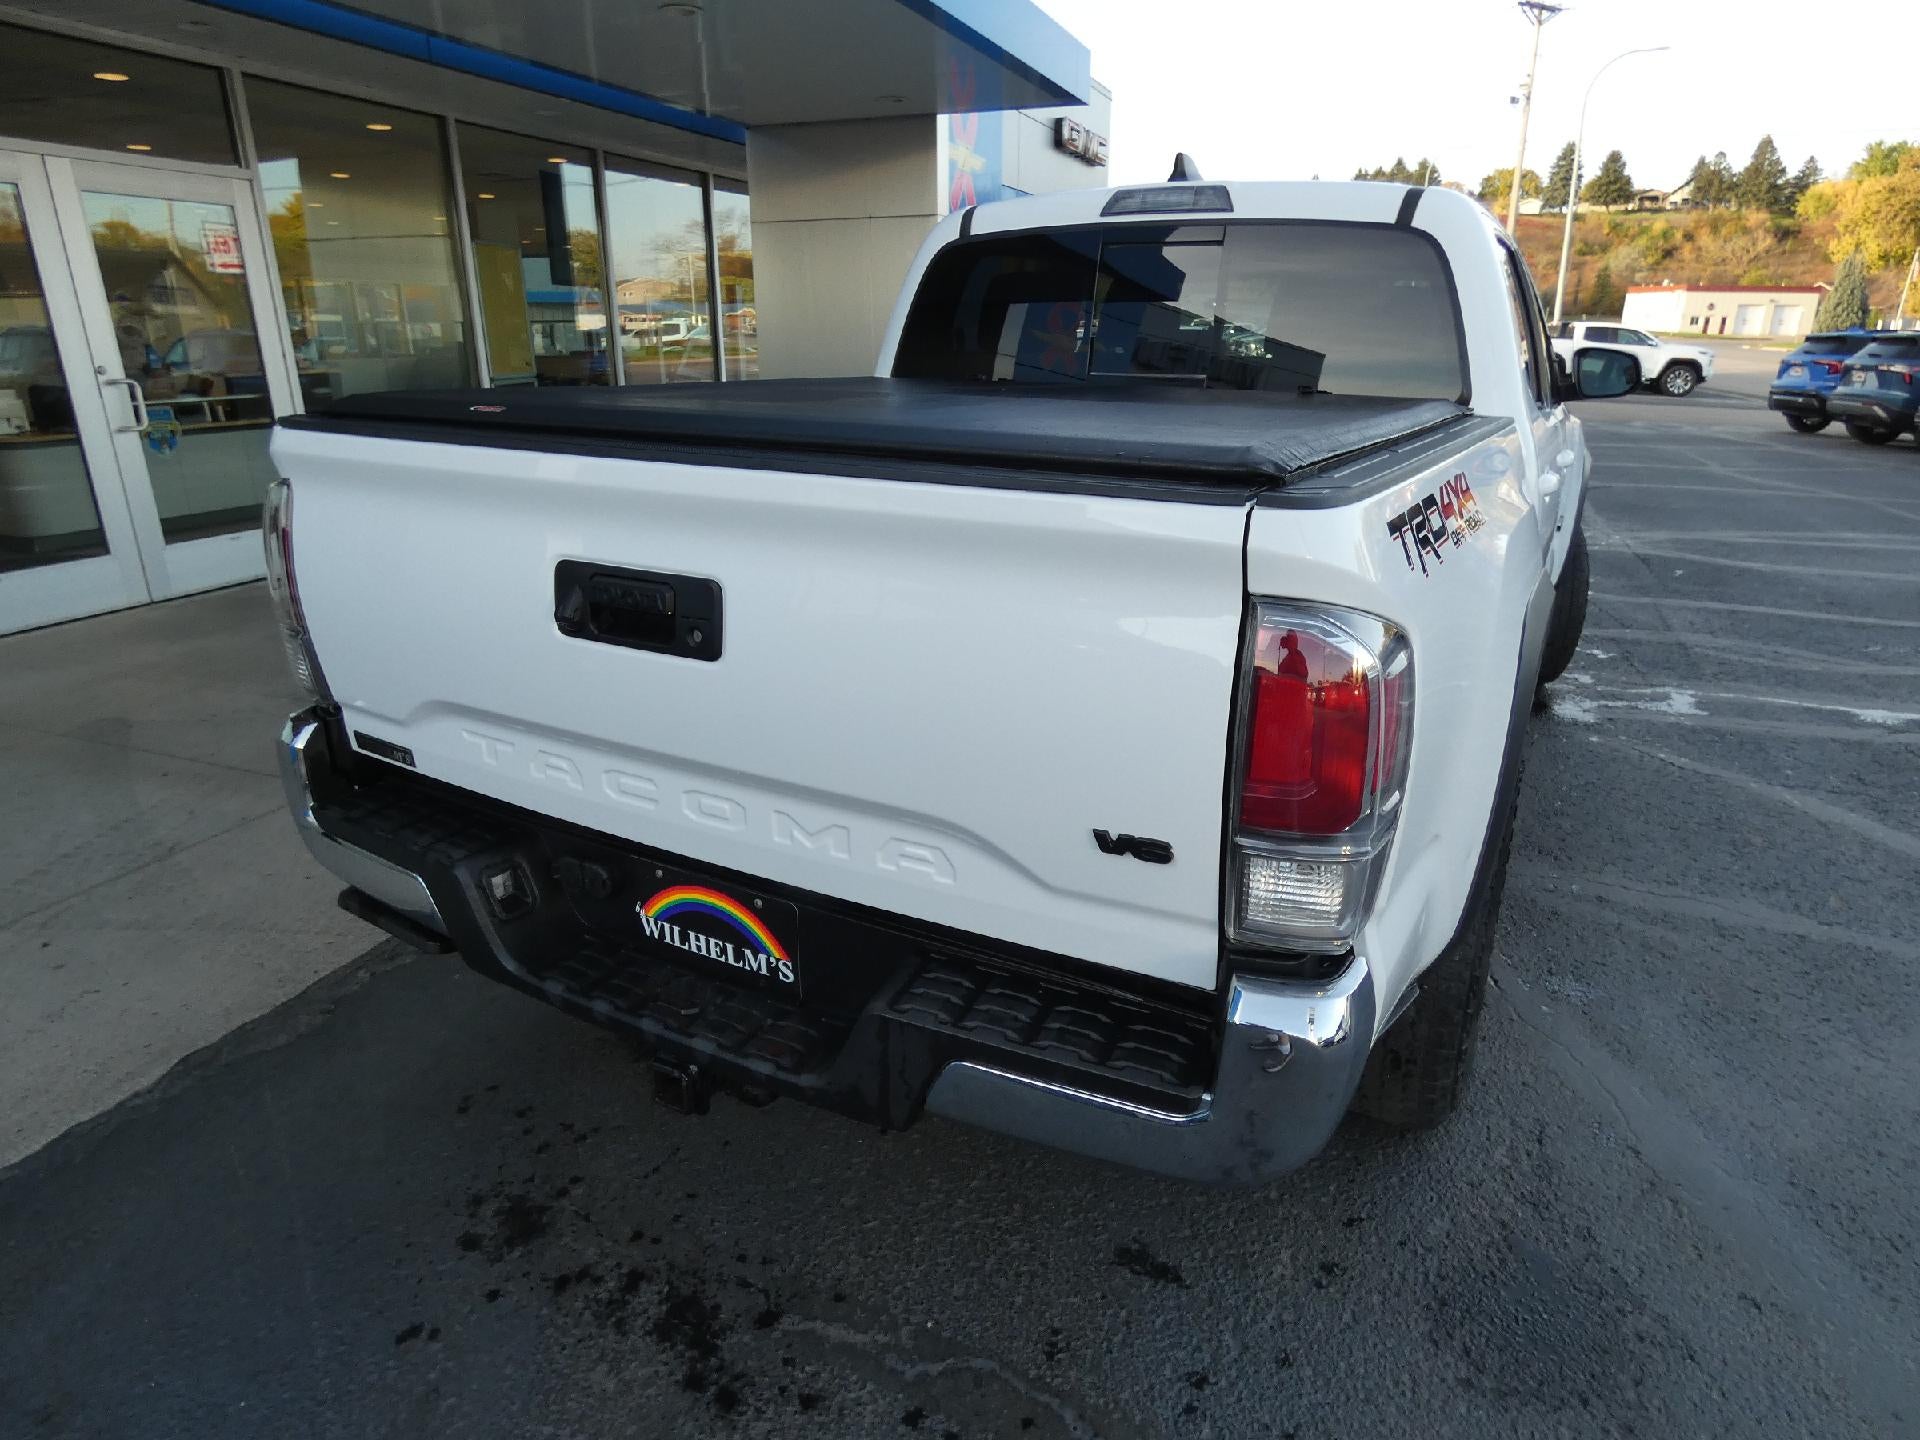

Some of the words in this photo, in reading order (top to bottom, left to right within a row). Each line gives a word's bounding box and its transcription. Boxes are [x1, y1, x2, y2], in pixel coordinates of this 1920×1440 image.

[1060, 116, 1109, 166] GMC
[1386, 493, 1449, 578] TRD
[461, 728, 957, 885] TACOMA
[1093, 828, 1175, 865] V6
[640, 914, 795, 983] WILHELM'S
